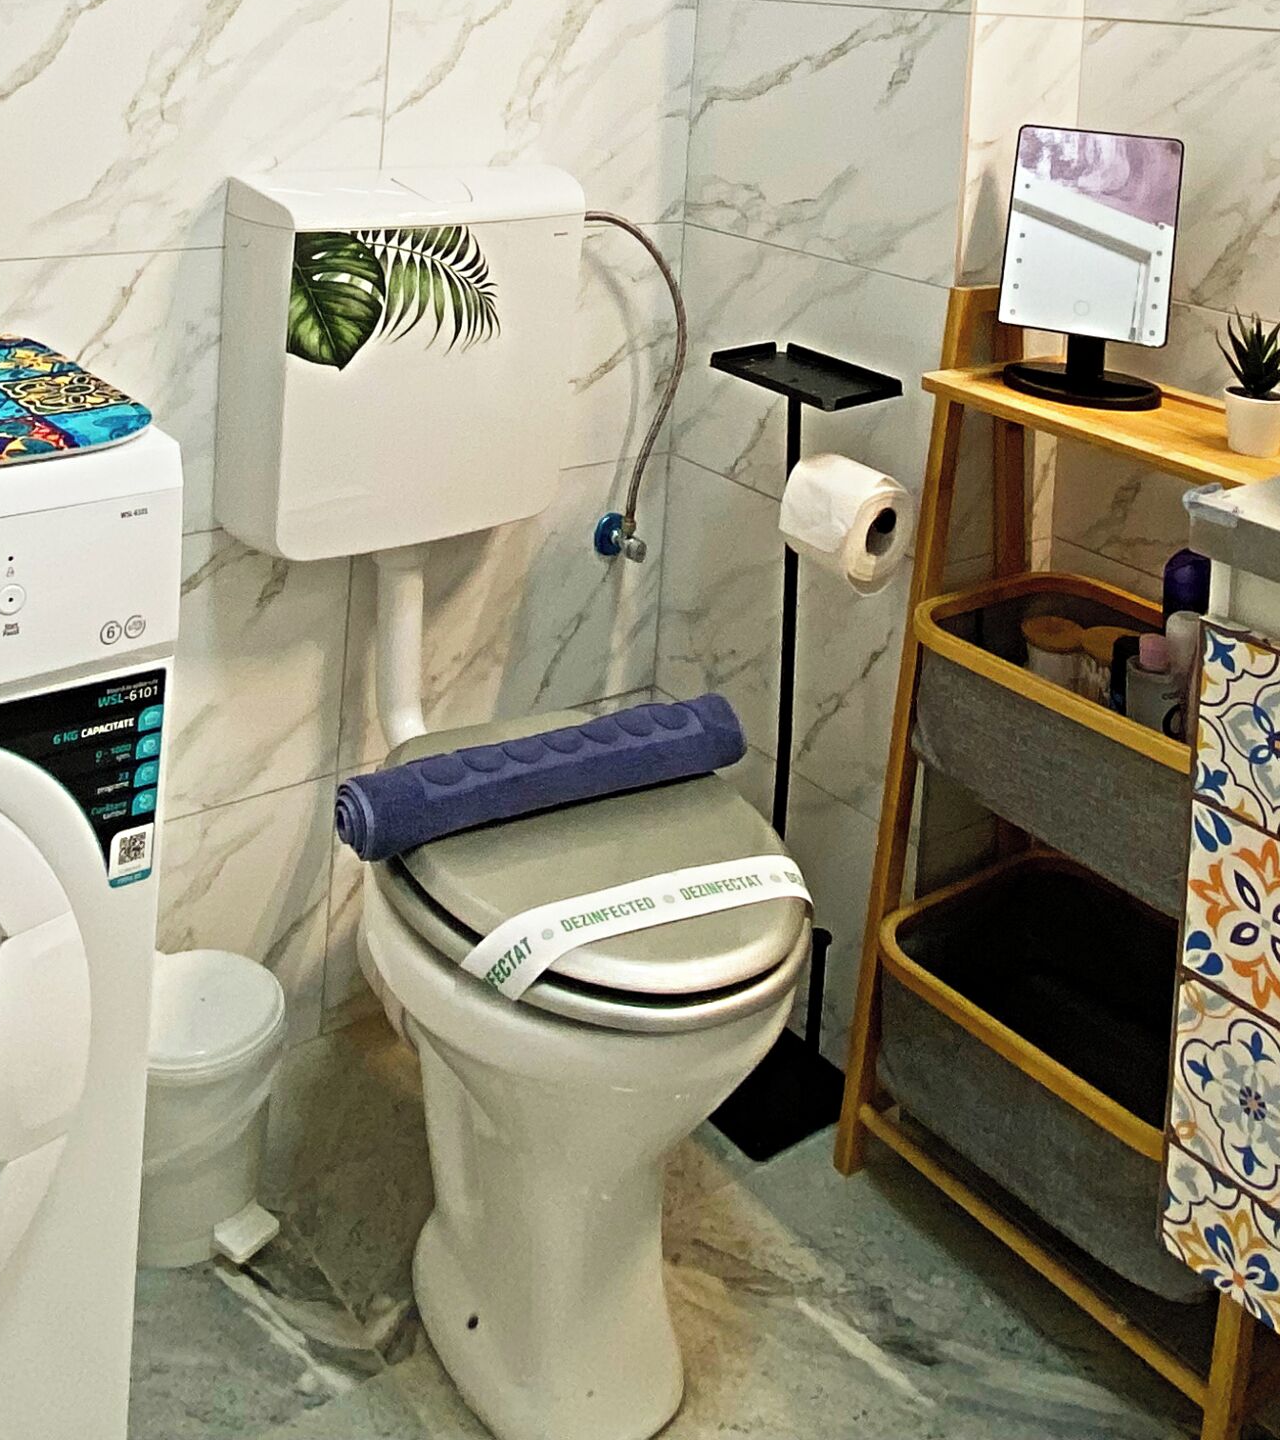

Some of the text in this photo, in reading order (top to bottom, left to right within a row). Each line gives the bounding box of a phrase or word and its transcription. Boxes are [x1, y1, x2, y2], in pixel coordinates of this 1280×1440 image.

[98, 685, 159, 708] WSL-6101
[53, 717, 135, 745] 6 KG CAPACITATE
[484, 936, 532, 986] FECTAT
[560, 897, 656, 933] DEZINFECTED
[679, 873, 764, 901] DEZINFECTAT
